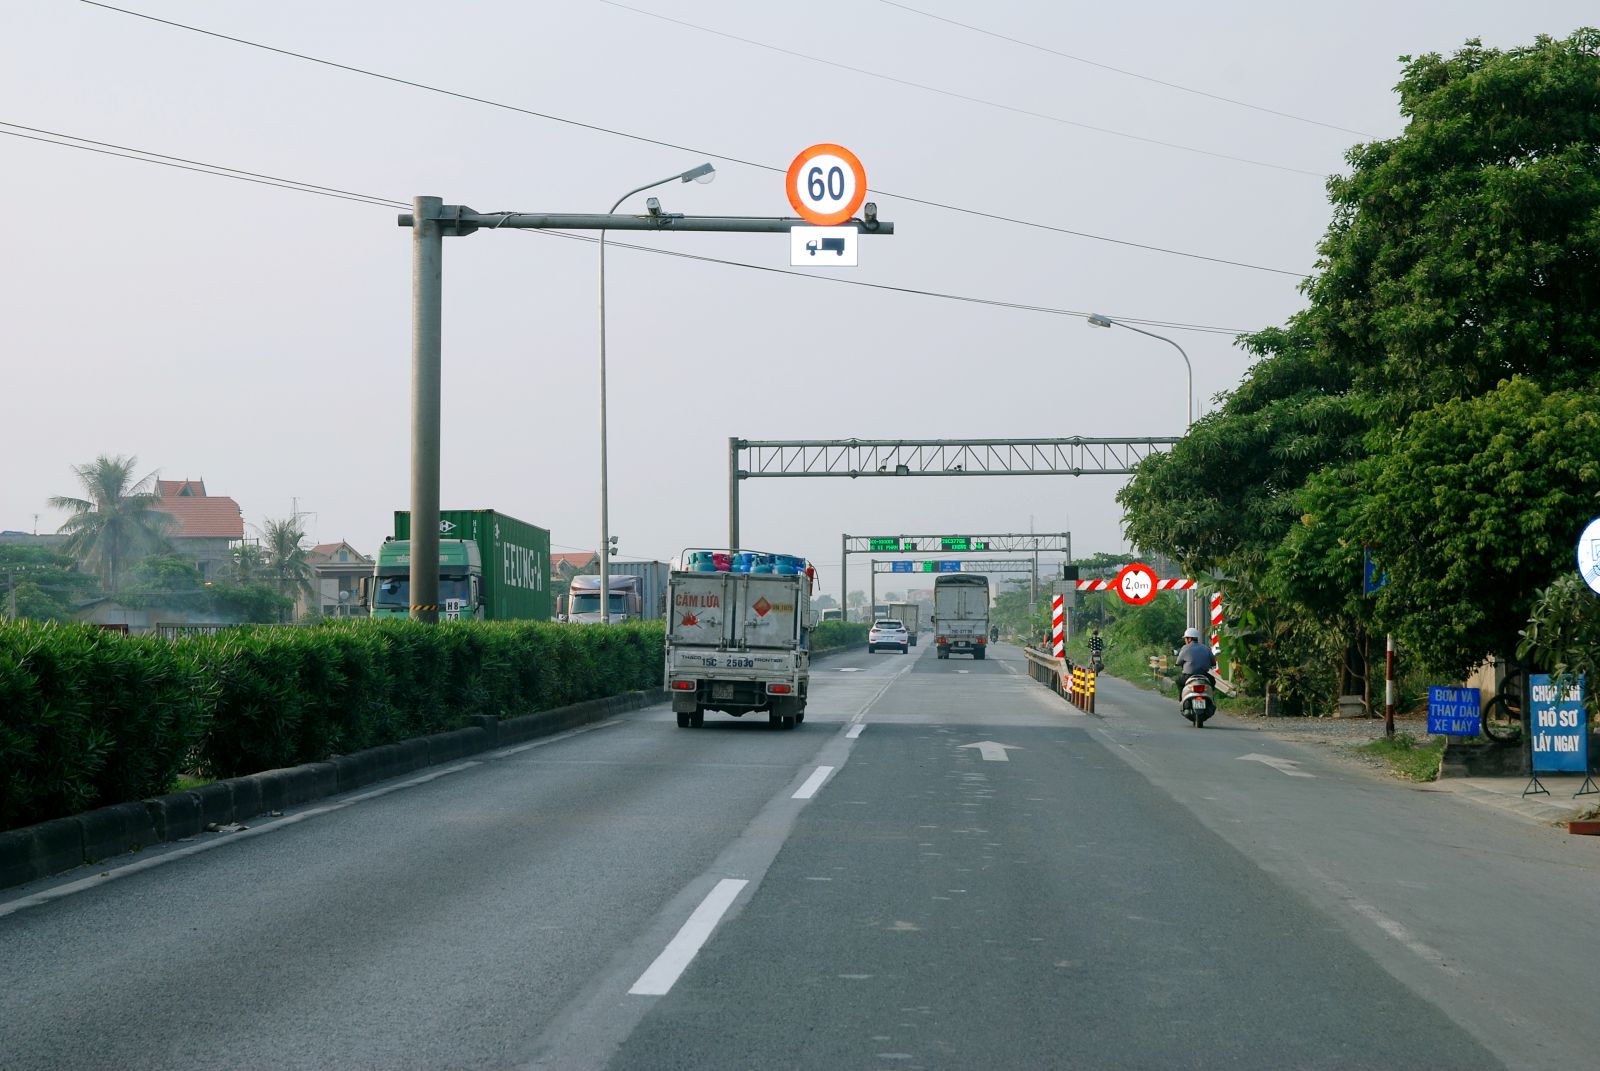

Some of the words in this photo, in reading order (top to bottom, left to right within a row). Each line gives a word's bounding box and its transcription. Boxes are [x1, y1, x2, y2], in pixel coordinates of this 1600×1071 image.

[807, 166, 845, 202] 60
[503, 541, 542, 592] HEUNG-A
[1125, 577, 1149, 591] 2,0m
[1430, 703, 1457, 717] THAY
[1538, 706, 1557, 727] HỒ
[1559, 709, 1579, 727] SƠ
[1434, 718, 1448, 731] XE
[1533, 730, 1552, 752] LẤY
[1553, 735, 1580, 752] NGAY
